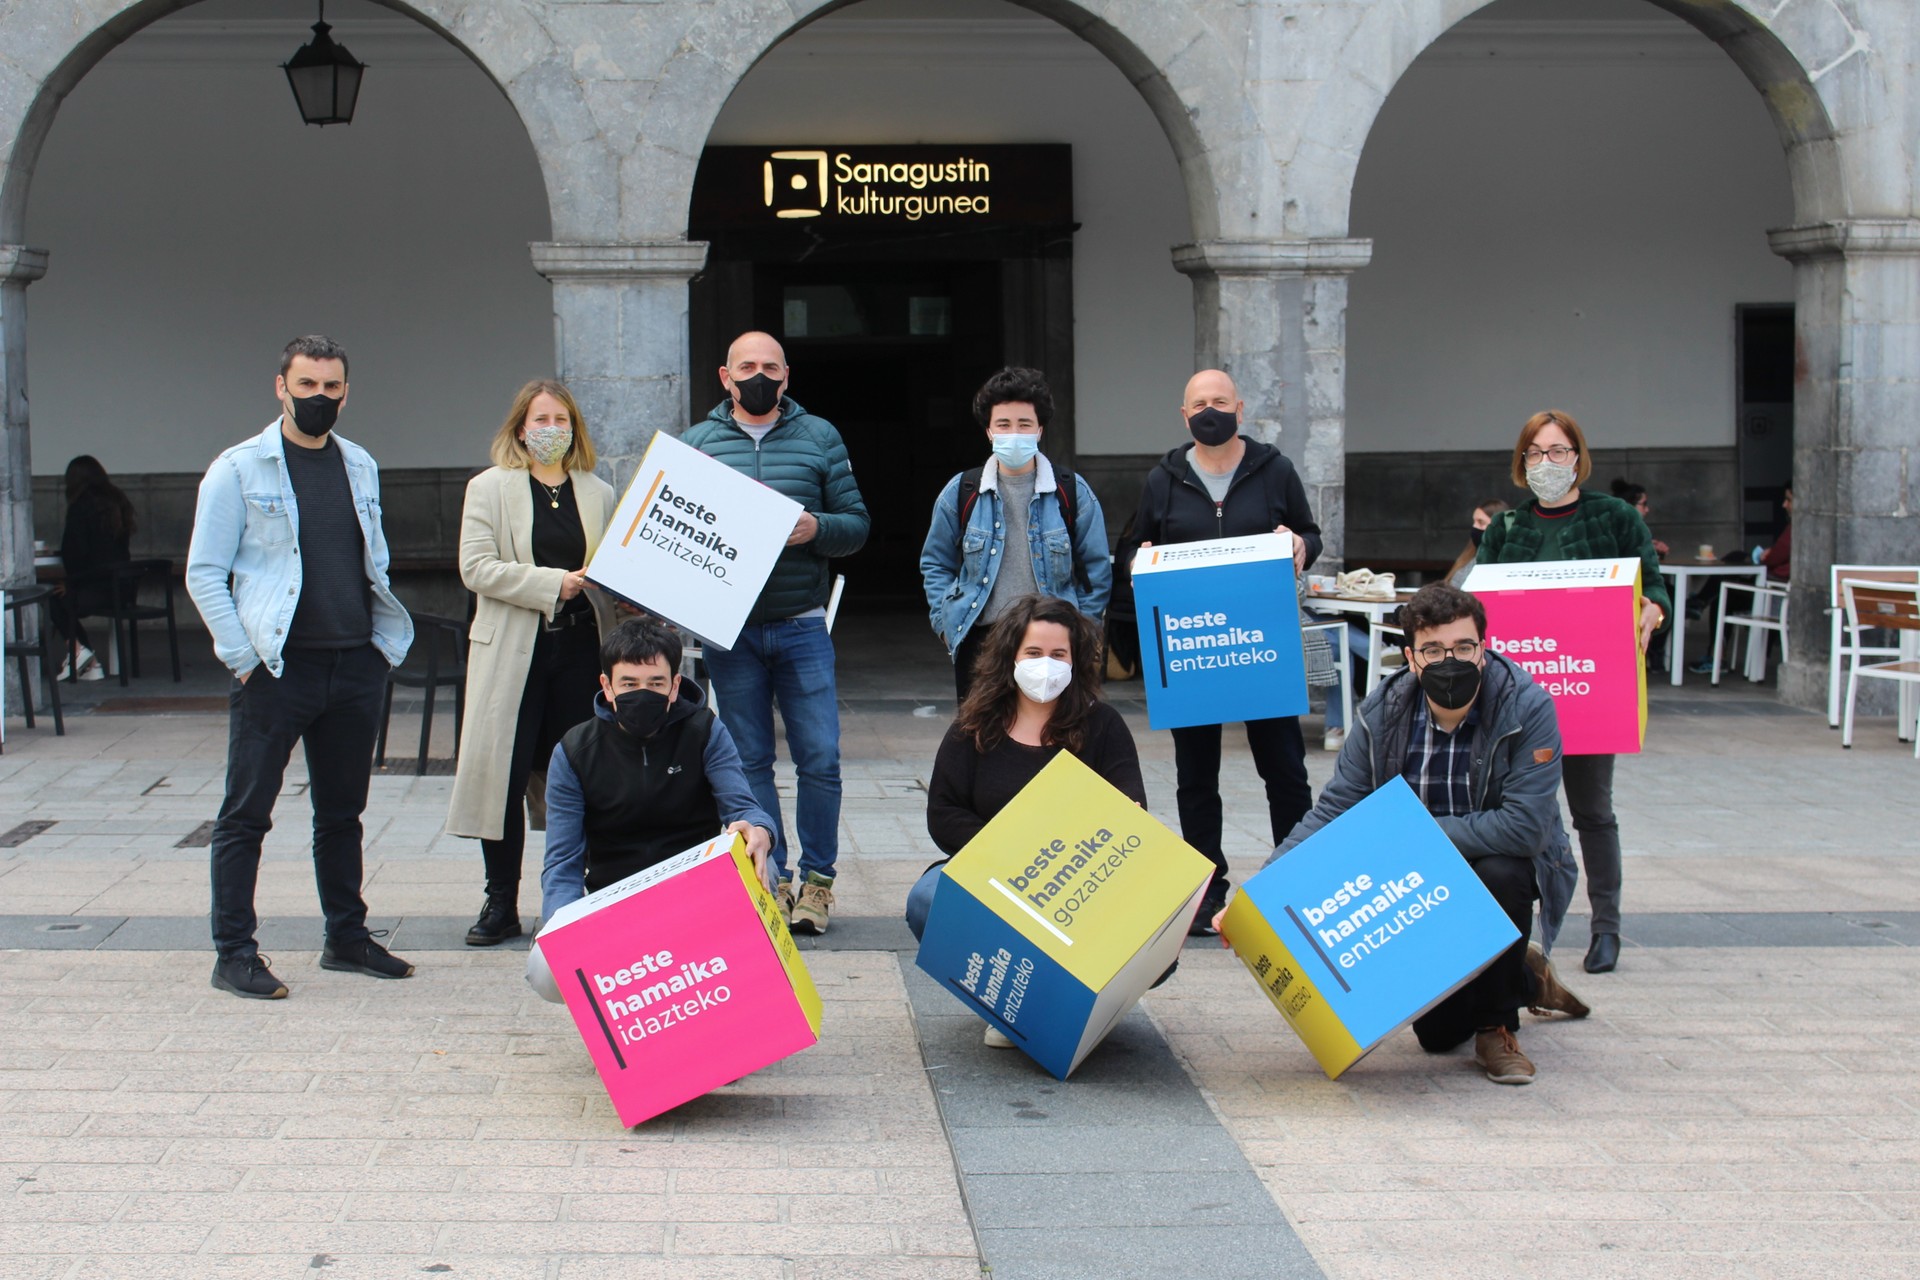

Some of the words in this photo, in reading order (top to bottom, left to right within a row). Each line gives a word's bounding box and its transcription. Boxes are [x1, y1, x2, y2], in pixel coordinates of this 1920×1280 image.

[834, 153, 990, 189] Sanagustin
[837, 185, 990, 221] kulturgunea
[658, 484, 717, 525] beste
[648, 504, 738, 561] hamaika
[1164, 611, 1227, 631] beste
[1166, 627, 1264, 652] hamaika
[1491, 636, 1557, 654] beste
[1169, 647, 1278, 673] entzuteko
[1006, 838, 1066, 892] beste
[1027, 826, 1114, 909] hamaika
[1053, 834, 1141, 928] gozatzeko
[1302, 873, 1373, 927] beste
[1318, 870, 1425, 949] hamaika
[1338, 885, 1450, 969] entzuteko
[594, 950, 674, 995] beste
[605, 956, 729, 1021] hamaika
[959, 951, 985, 993] beste
[978, 947, 1013, 1009] hamaika
[1003, 957, 1035, 1024] entzuteko
[617, 985, 731, 1046] idazteko
